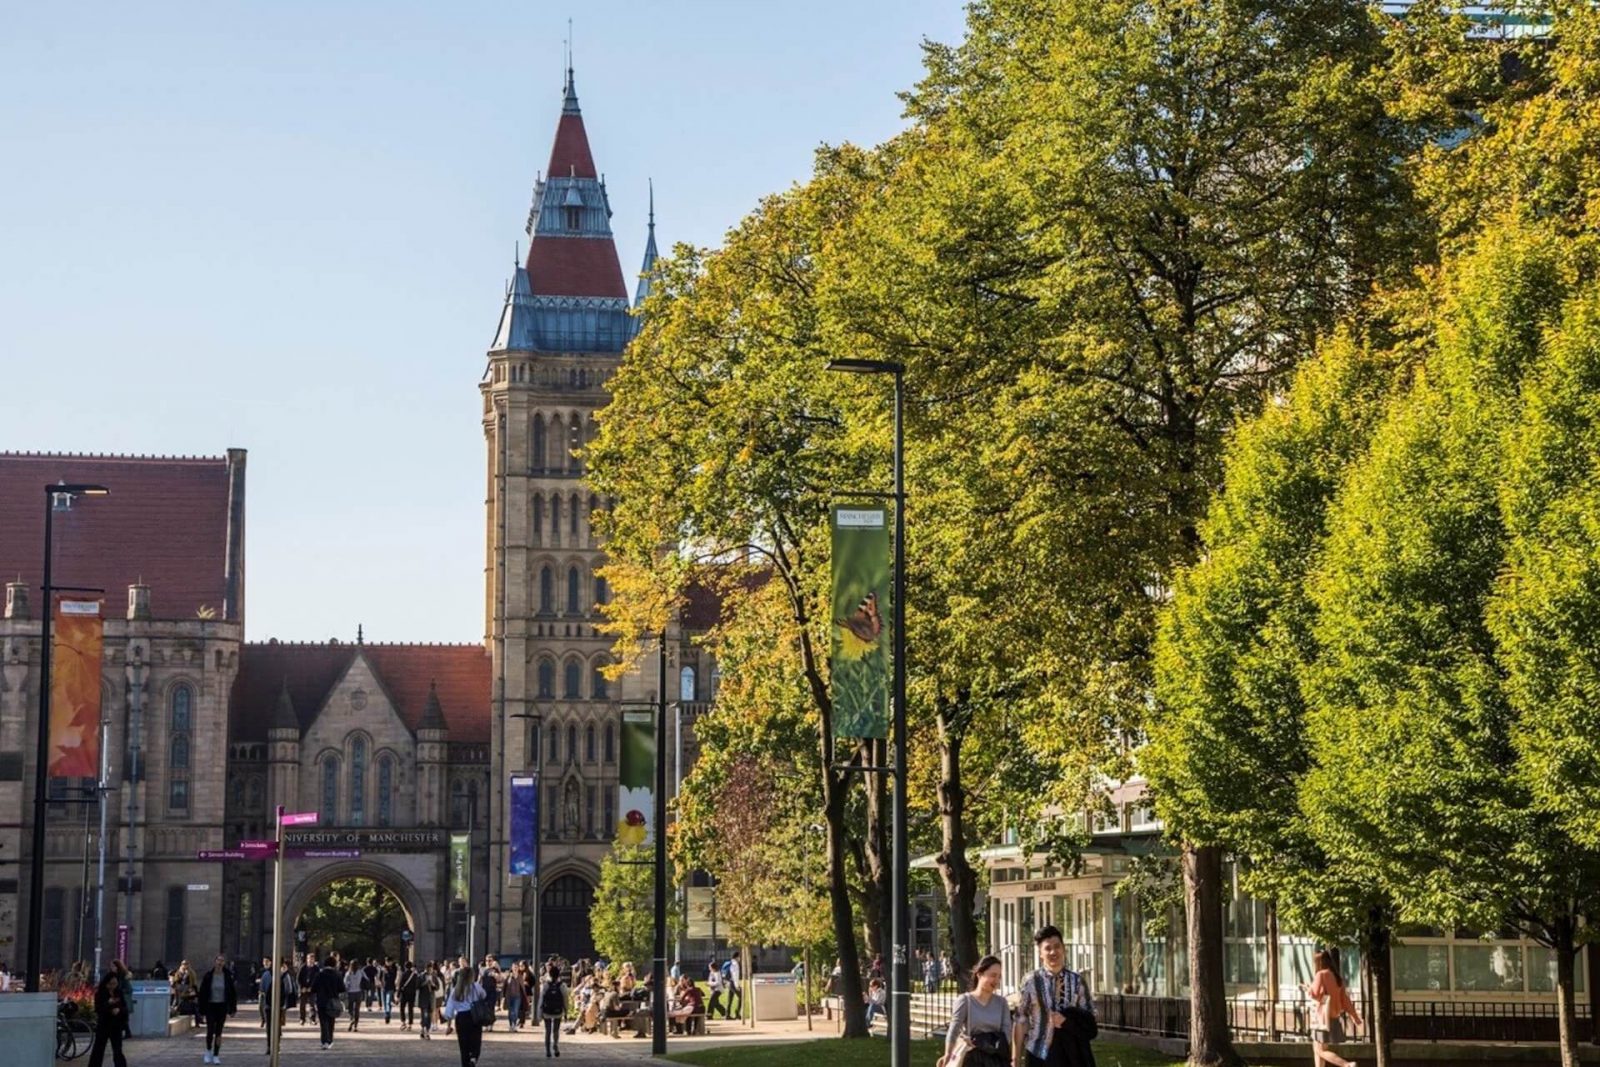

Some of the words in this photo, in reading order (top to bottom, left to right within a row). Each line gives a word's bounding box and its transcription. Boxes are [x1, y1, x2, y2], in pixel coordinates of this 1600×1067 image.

[284, 833, 339, 843] NIVERSITY
[346, 834, 360, 842] OF
[369, 833, 439, 842] MANCHESTER
